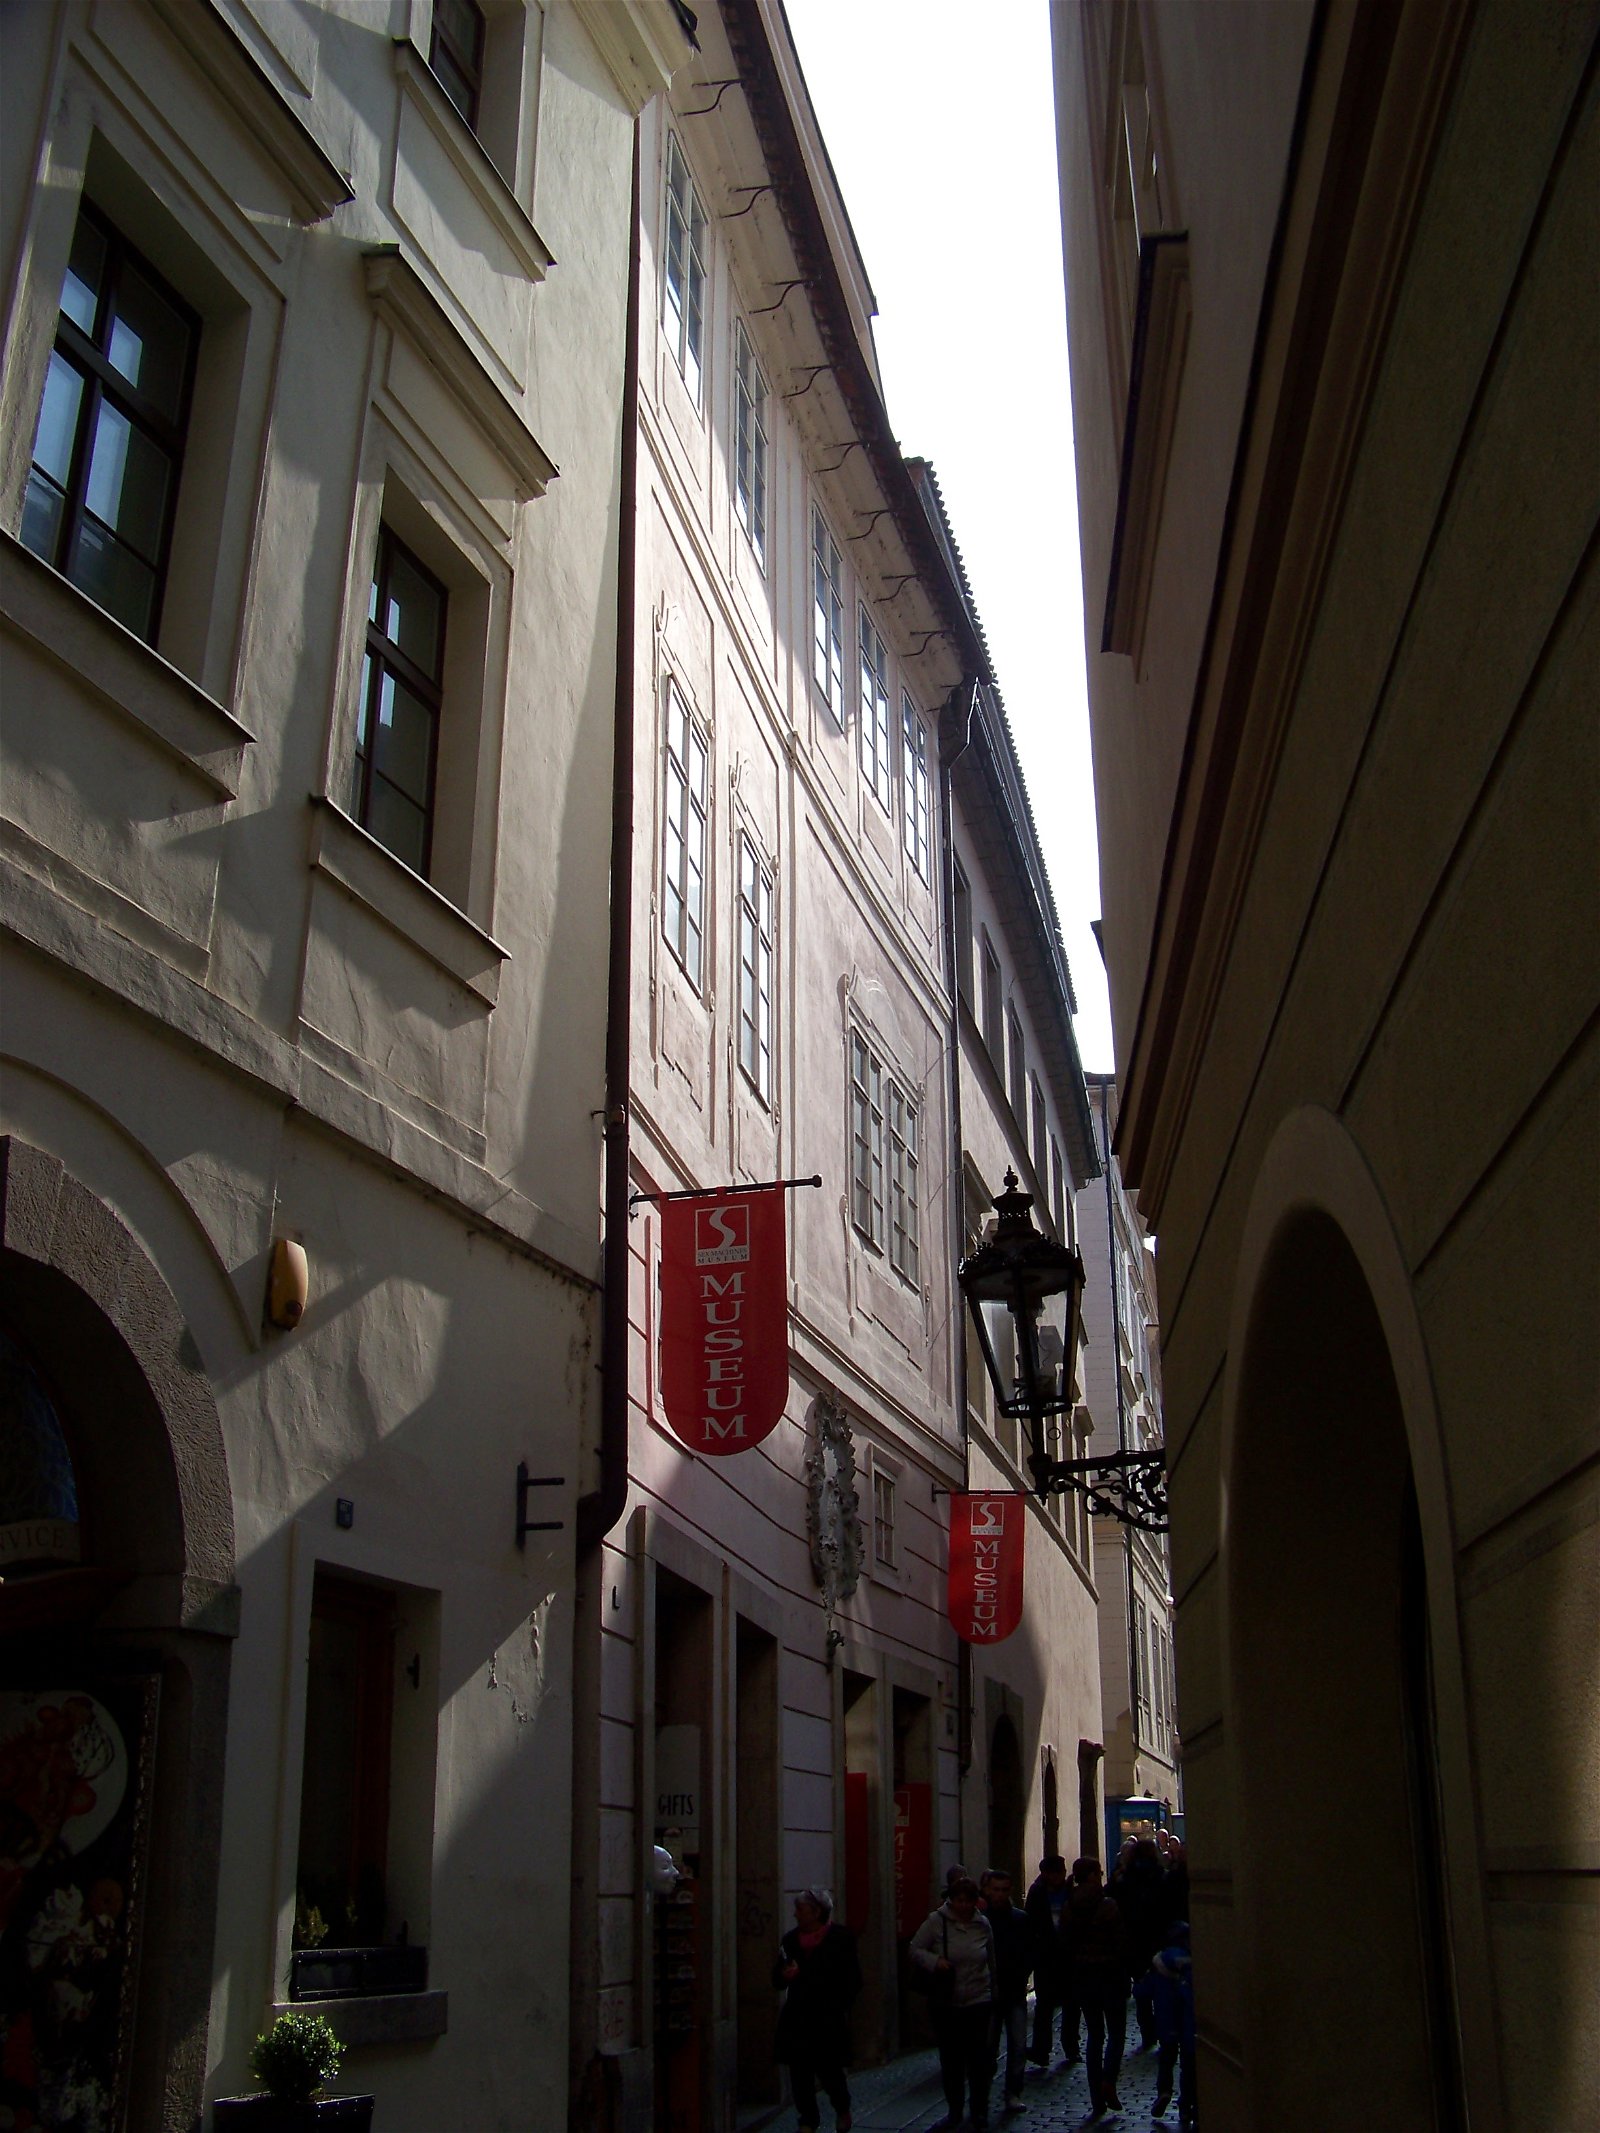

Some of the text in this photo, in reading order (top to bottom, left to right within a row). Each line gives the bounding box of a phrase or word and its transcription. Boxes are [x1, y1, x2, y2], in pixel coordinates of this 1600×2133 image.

[700, 1271, 748, 1441] MUSEUM
[970, 1540, 1000, 1637] MUSEUM
[658, 1794, 694, 1815] GIFTS
